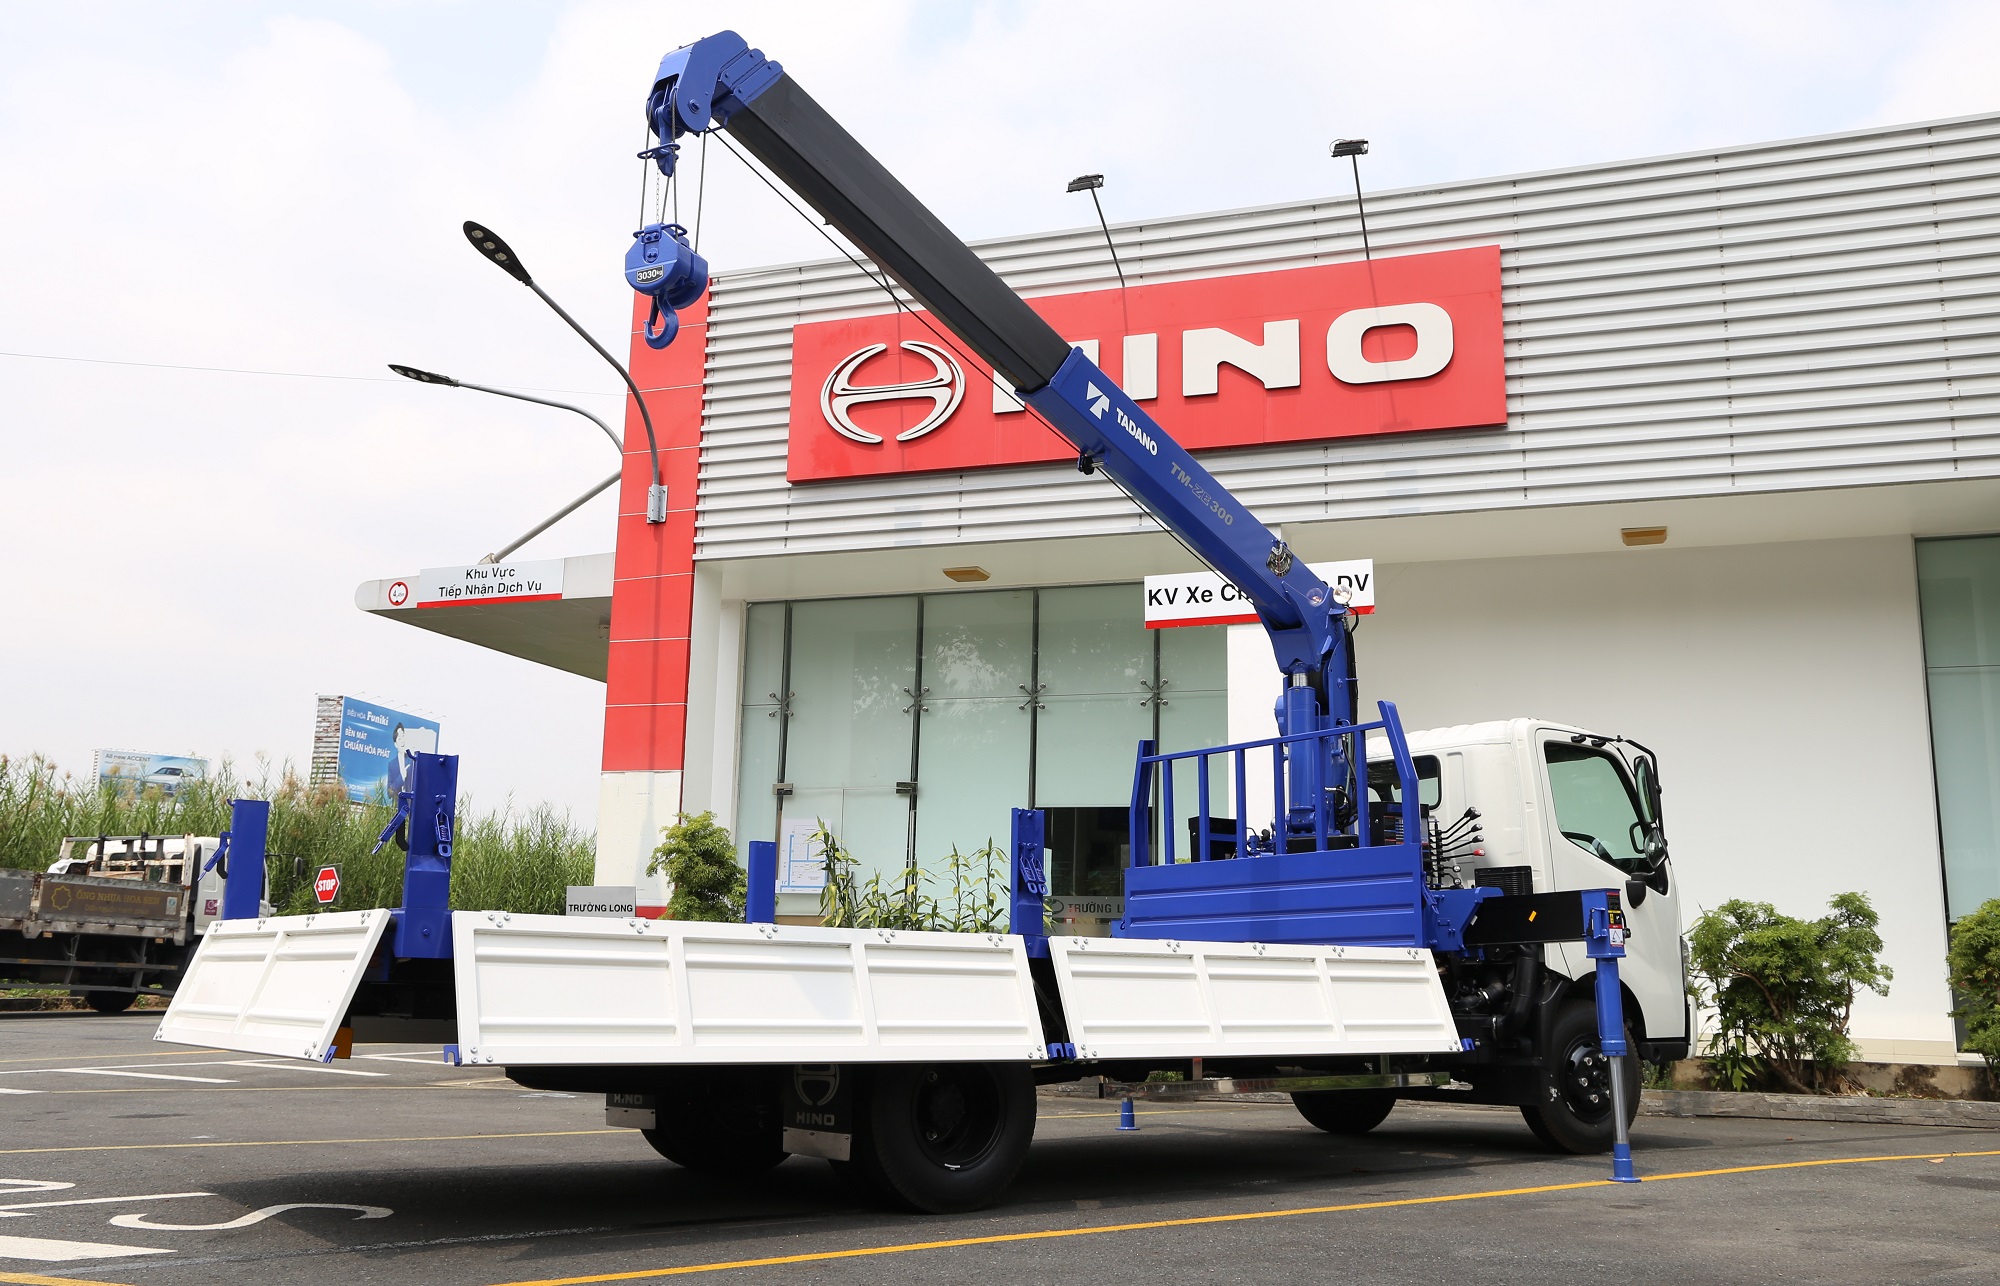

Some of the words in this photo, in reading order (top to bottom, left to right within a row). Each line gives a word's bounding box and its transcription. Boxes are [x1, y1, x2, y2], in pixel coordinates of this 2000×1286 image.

[1116, 407, 1158, 456] TADANO
[465, 568, 488, 580] Khu
[492, 567, 516, 581] Vực
[438, 584, 462, 598] Tiếp
[465, 583, 494, 597] Nhận
[497, 581, 523, 595] Dịch
[527, 580, 542, 593] Vụ
[1148, 587, 1179, 606] KV
[1186, 586, 1213, 604] Xe
[1337, 573, 1369, 592] DV
[317, 878, 336, 892] STOP
[568, 901, 607, 912] TRƯỜNG
[609, 904, 633, 912] LONG
[1068, 901, 1112, 913] TRƯỜNG
[613, 1092, 643, 1105] HINO
[796, 1111, 835, 1126] HINO
